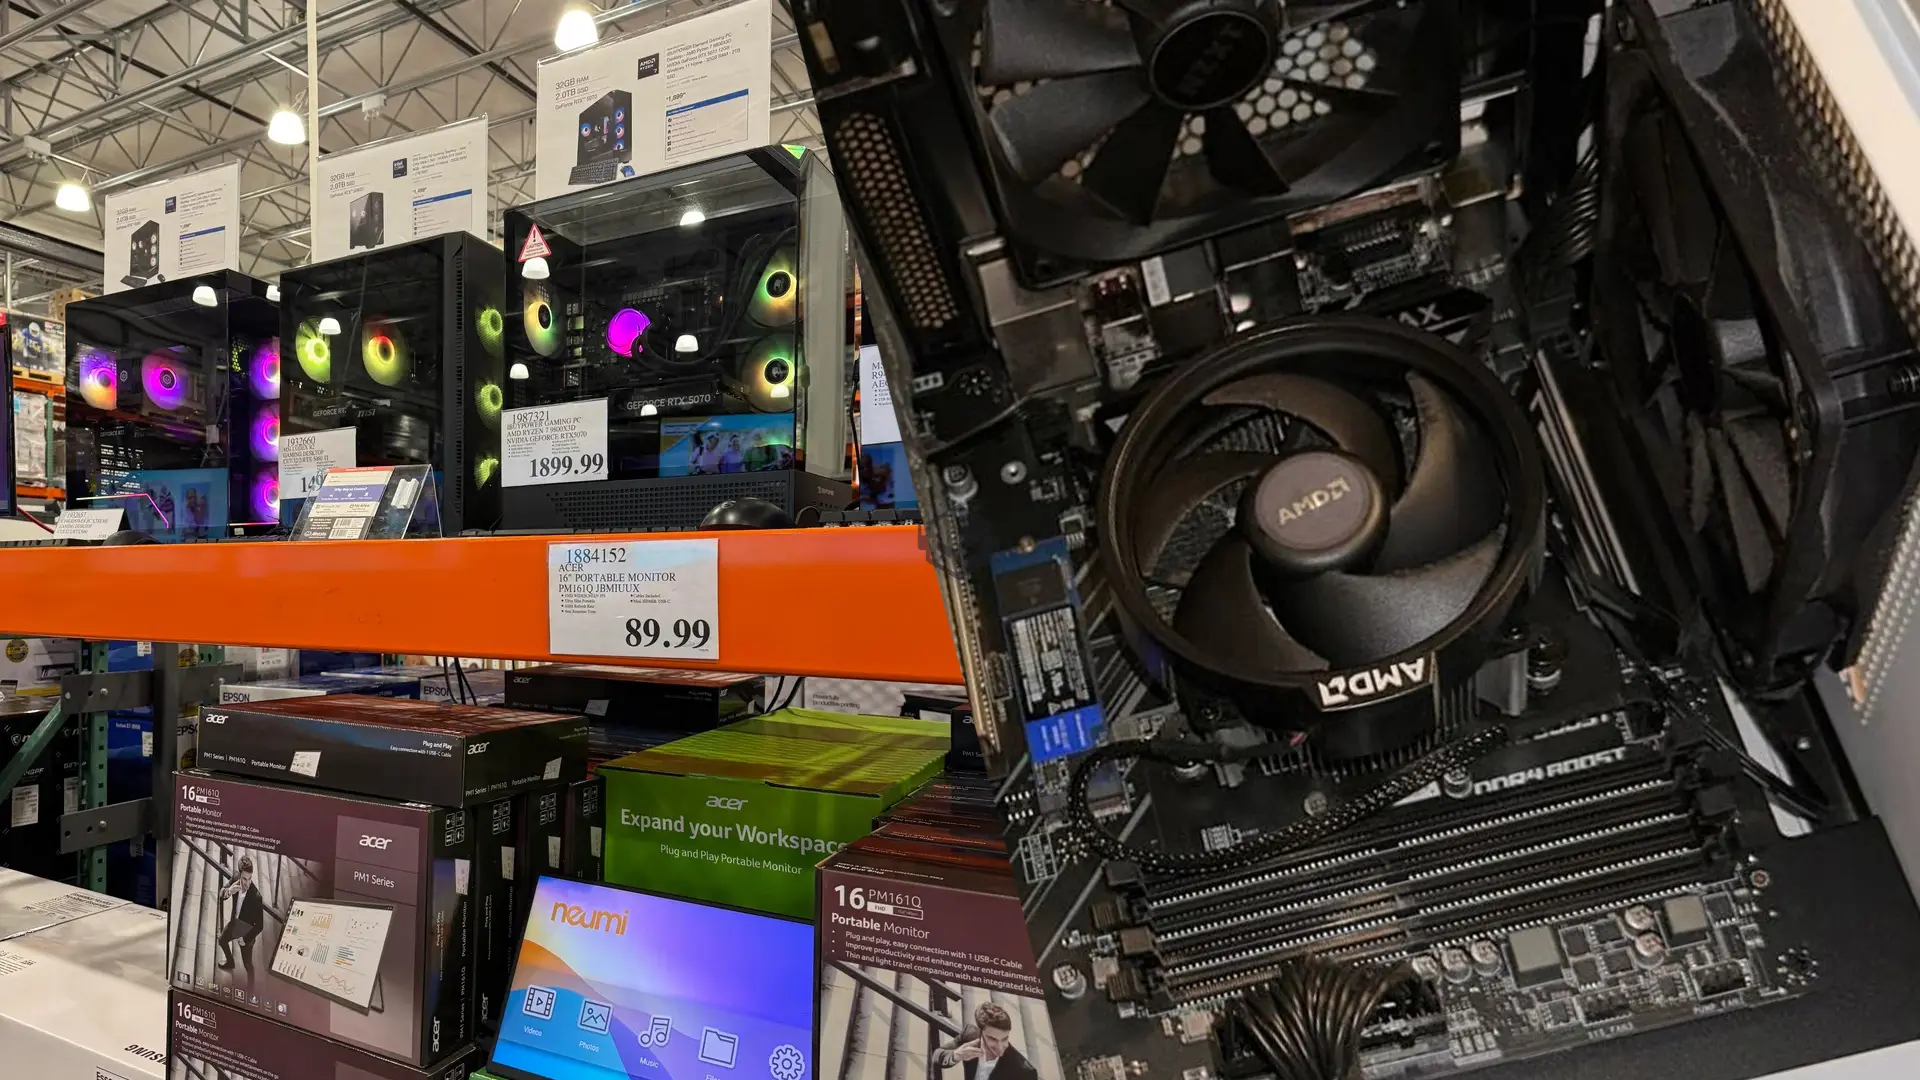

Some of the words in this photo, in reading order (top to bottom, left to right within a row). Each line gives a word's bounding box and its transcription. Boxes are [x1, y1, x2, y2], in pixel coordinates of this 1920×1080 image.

[640, 58, 654, 67] AMD
[556, 78, 576, 90] 32GB
[556, 88, 576, 100] 2.0TB
[577, 86, 588, 94] SSD
[554, 102, 573, 110] GeForce
[330, 172, 345, 181] 32GB
[330, 182, 345, 190] 2.0TB
[627, 398, 666, 410] GEFORCE
[667, 396, 684, 406] RTX
[689, 394, 710, 404] 5070
[312, 408, 337, 417] GEFORCE
[512, 411, 549, 424] 1987321
[544, 418, 571, 426] GAMING
[522, 427, 544, 436] RYZEN
[550, 425, 576, 433] 9800X3D
[288, 436, 316, 447] 1932660
[507, 436, 529, 444] NVIDIA
[530, 433, 559, 442] GEFORCE
[560, 431, 587, 439] RTX5070
[529, 453, 604, 478] 1899.99
[1278, 480, 1341, 524] AMD
[566, 548, 626, 564] 1884152
[558, 563, 584, 572] ACER
[559, 574, 572, 582] 16"
[575, 573, 624, 582] PORTABLE
[628, 573, 676, 582] MONITOR
[558, 584, 593, 594] PM161Q
[595, 584, 639, 593] JBMIUUX
[625, 618, 710, 649] 89.99
[513, 676, 532, 684] acer
[1330, 656, 1425, 700] AMD
[223, 692, 250, 702] EPSON
[423, 686, 450, 697] EPSO
[206, 714, 229, 724] acer
[423, 740, 432, 748] Plug
[467, 742, 489, 755] acer
[213, 753, 225, 761] Series
[229, 755, 246, 764] PM161Q
[252, 760, 269, 768] Portable
[269, 762, 286, 770] Monitor
[182, 785, 195, 800] 16
[197, 787, 220, 798] PM161Q
[465, 788, 474, 797] PM1
[475, 786, 487, 795] Series
[512, 777, 526, 786] Portable
[706, 795, 748, 811] acer
[180, 804, 202, 814] Portable
[202, 808, 222, 817] Monitor
[621, 808, 684, 833] Expand
[689, 821, 732, 840] your
[359, 835, 392, 850] acer
[660, 844, 680, 858] Plug
[682, 849, 698, 859] and
[700, 850, 719, 864] Play
[721, 853, 761, 868] Portable
[763, 860, 802, 875] Monitor
[354, 871, 369, 882] PM1
[371, 874, 394, 888] Series
[834, 885, 865, 910] 16
[868, 889, 922, 908] PM161Q
[551, 902, 629, 936] neumi
[831, 913, 880, 931] Portable
[884, 922, 929, 940] Monitor
[846, 931, 860, 941] Plug
[876, 937, 892, 946] play,
[893, 941, 908, 949] easy
[910, 943, 949, 956] connection
[950, 950, 966, 958] with
[974, 954, 999, 965] USB-C
[1001, 958, 1023, 970] Cable
[846, 941, 872, 952] Improve
[874, 946, 915, 961] productivity
[931, 958, 962, 968] enhance
[963, 963, 980, 972] your
[981, 968, 1037, 983] entertainment
[846, 951, 860, 960] Thin
[862, 954, 874, 962] and
[876, 956, 892, 966] light
[893, 959, 912, 970] travel
[914, 965, 953, 978] companion
[955, 972, 971, 980] with
[983, 977, 1023, 991] integrated
[177, 1002, 191, 1019] 16
[192, 1006, 216, 1020] PM161Q
[176, 1020, 198, 1035] Portable
[199, 1028, 219, 1040] Monitor
[432, 1016, 440, 1052] acer
[524, 1026, 542, 1037] Videos
[579, 1040, 599, 1053] Photos
[639, 1057, 659, 1068] Music
